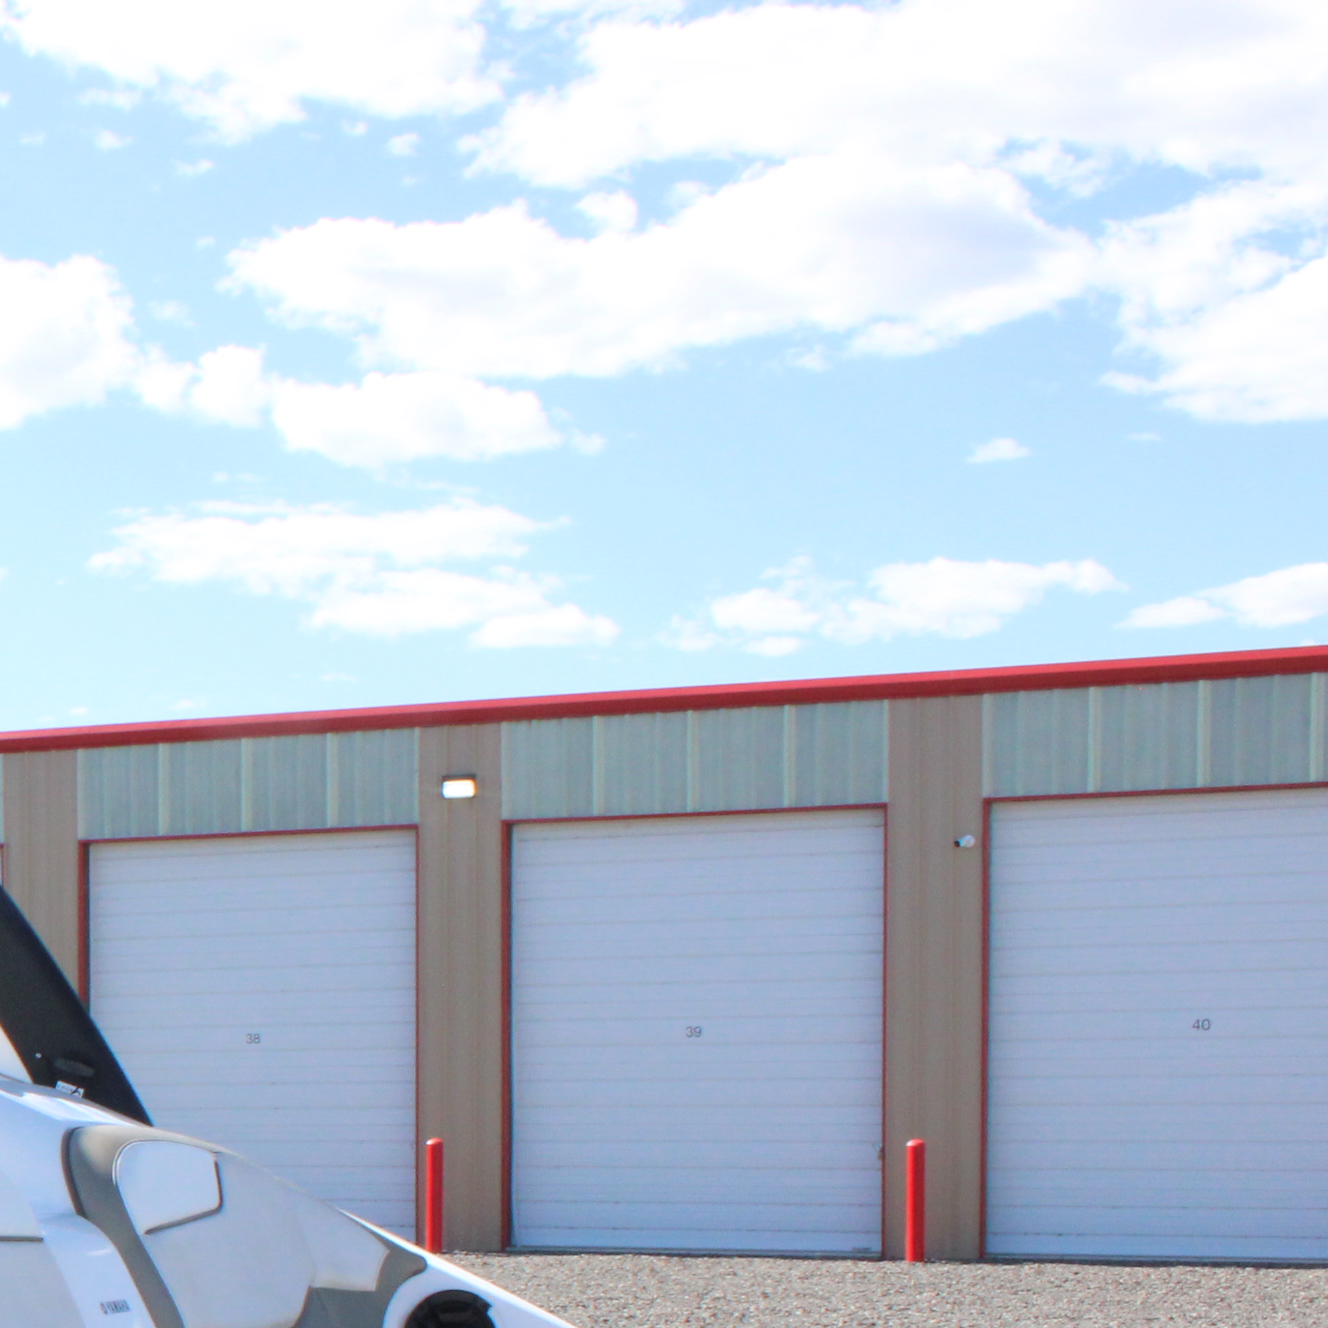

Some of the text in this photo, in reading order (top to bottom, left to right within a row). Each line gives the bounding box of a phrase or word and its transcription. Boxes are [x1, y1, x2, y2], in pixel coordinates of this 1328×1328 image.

[1192, 1018, 1211, 1031] 40
[685, 1025, 702, 1038] 39
[245, 1033, 261, 1044] 38
